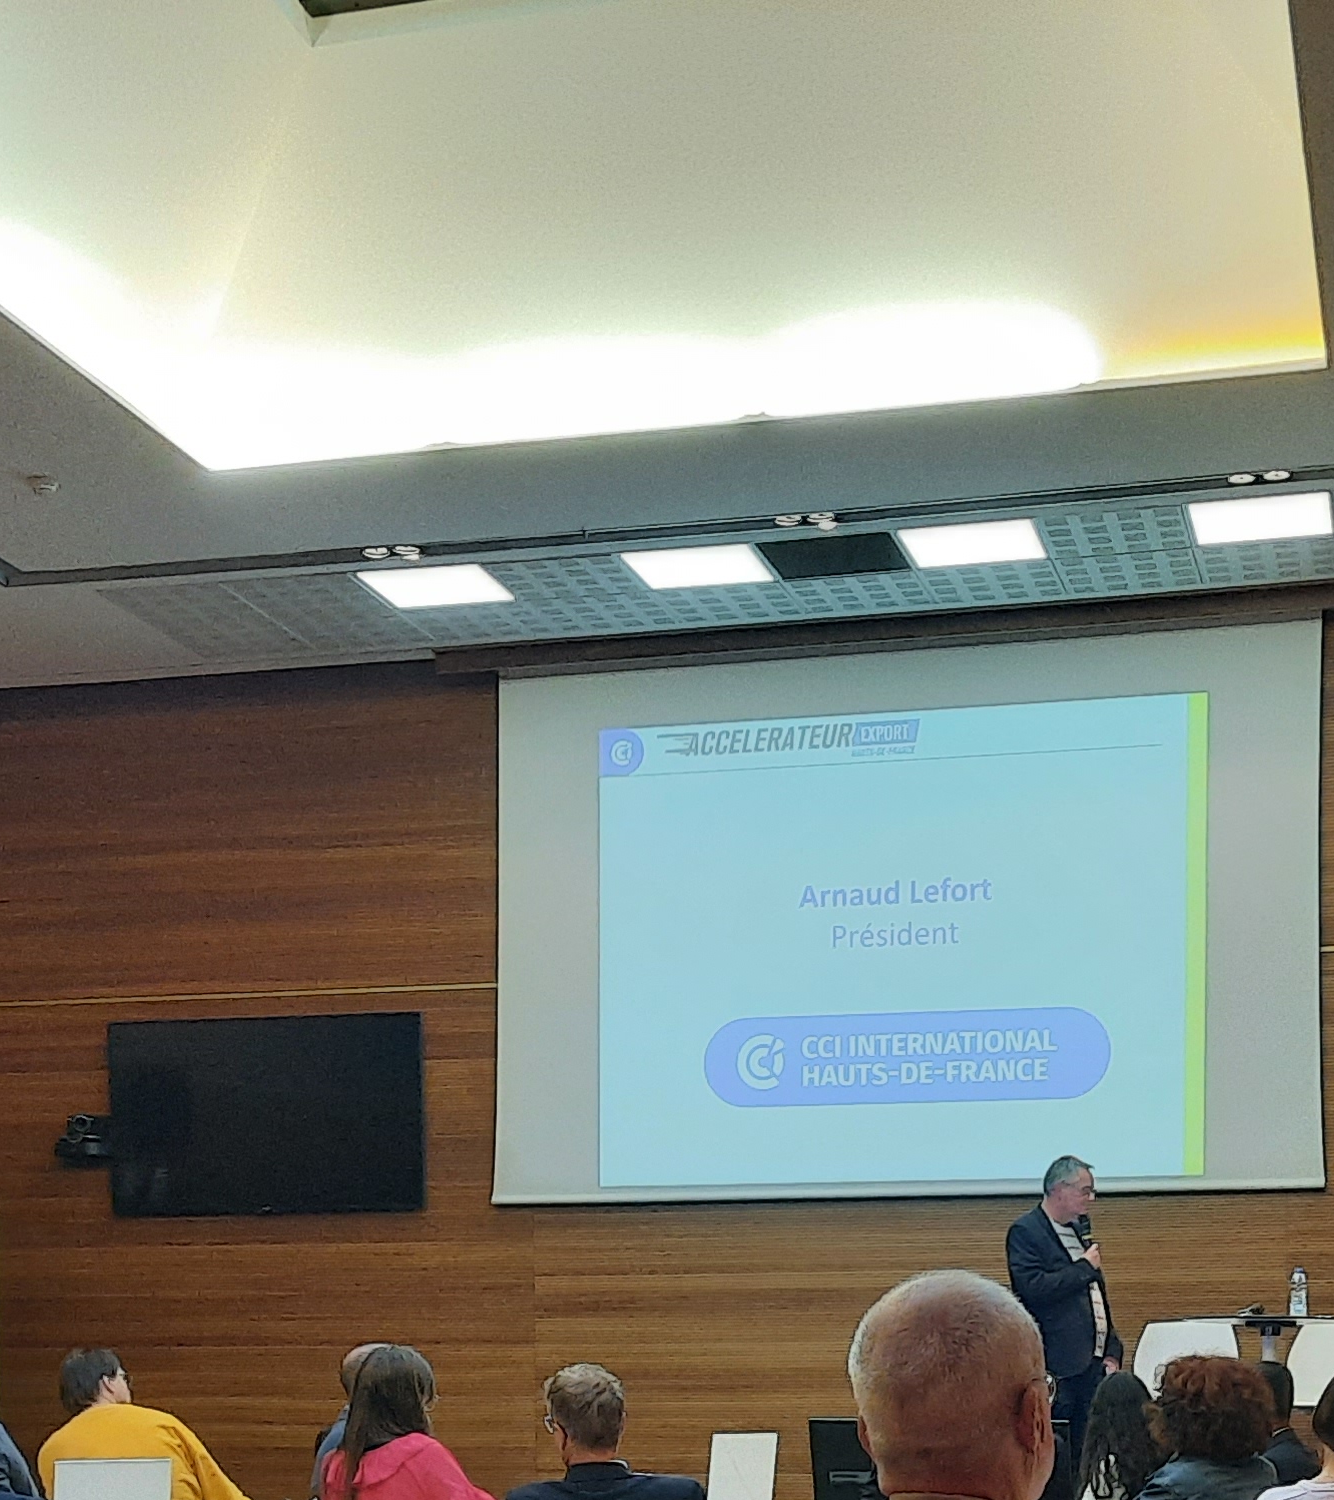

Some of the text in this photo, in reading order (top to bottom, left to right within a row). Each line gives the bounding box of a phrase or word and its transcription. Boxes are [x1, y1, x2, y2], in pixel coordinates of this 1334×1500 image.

[682, 722, 909, 757] ACCELERATEUR EXPORT
[798, 876, 993, 909] Arnaud Lefort
[831, 921, 960, 949] Président
[800, 1029, 1059, 1059] CCI INTERNATIONAL
[801, 1058, 1049, 1087] HAUTS-DE-FRANCE
